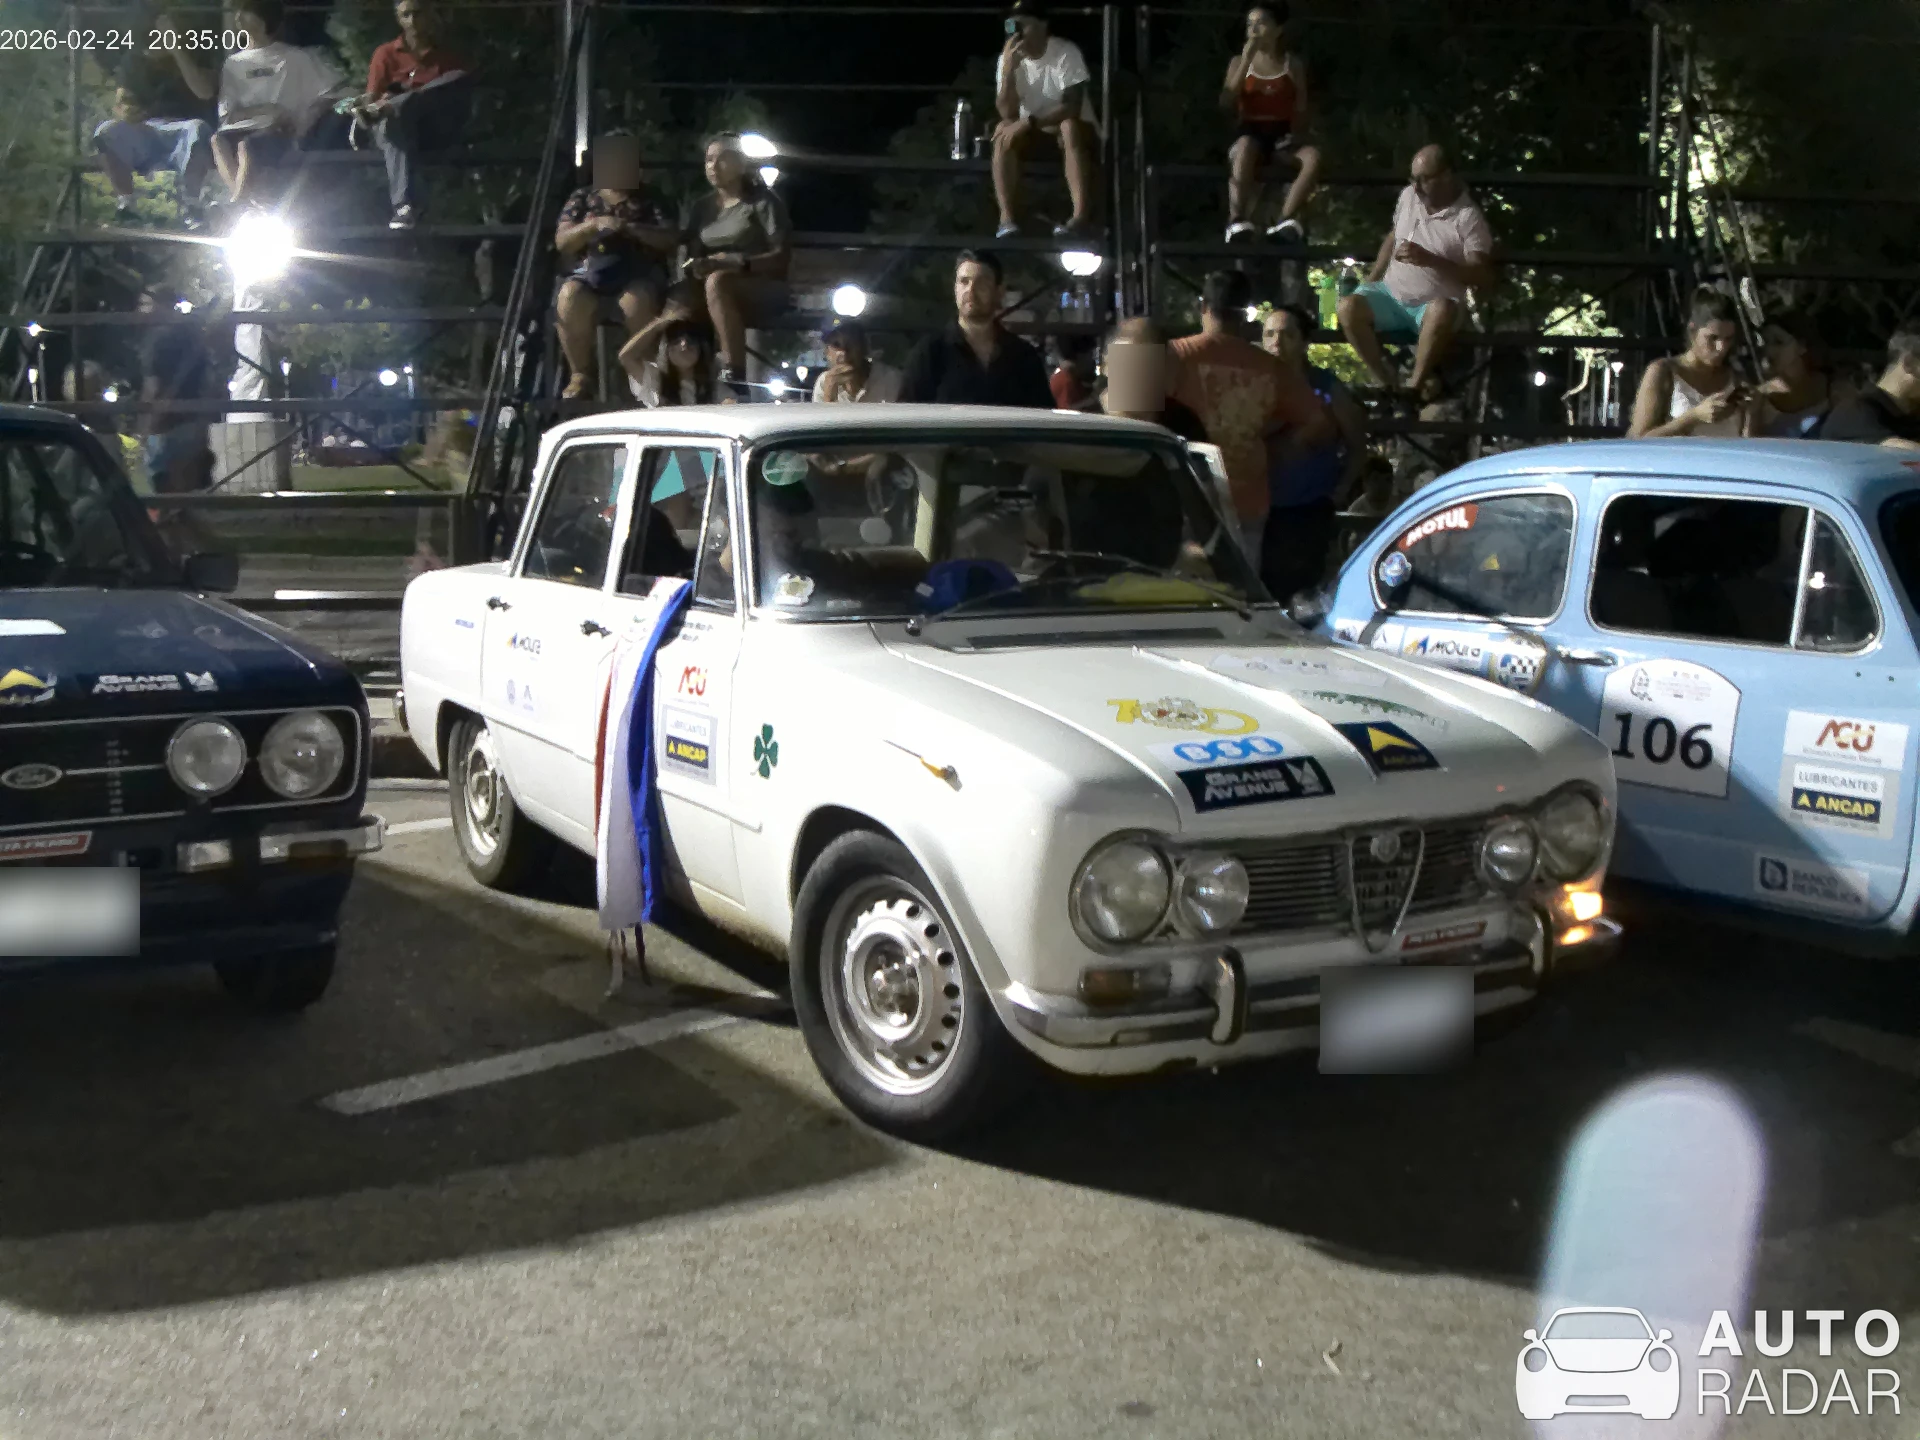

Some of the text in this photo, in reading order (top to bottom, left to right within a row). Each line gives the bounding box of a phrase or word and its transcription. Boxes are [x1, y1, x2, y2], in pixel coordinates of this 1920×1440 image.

[1405, 506, 1470, 546] MOTUL
[1611, 712, 1713, 770] 106
[1204, 780, 1290, 803] AVENUE
[1798, 771, 1879, 794] LUBRICANTES
[1815, 795, 1876, 817] ANCAP
